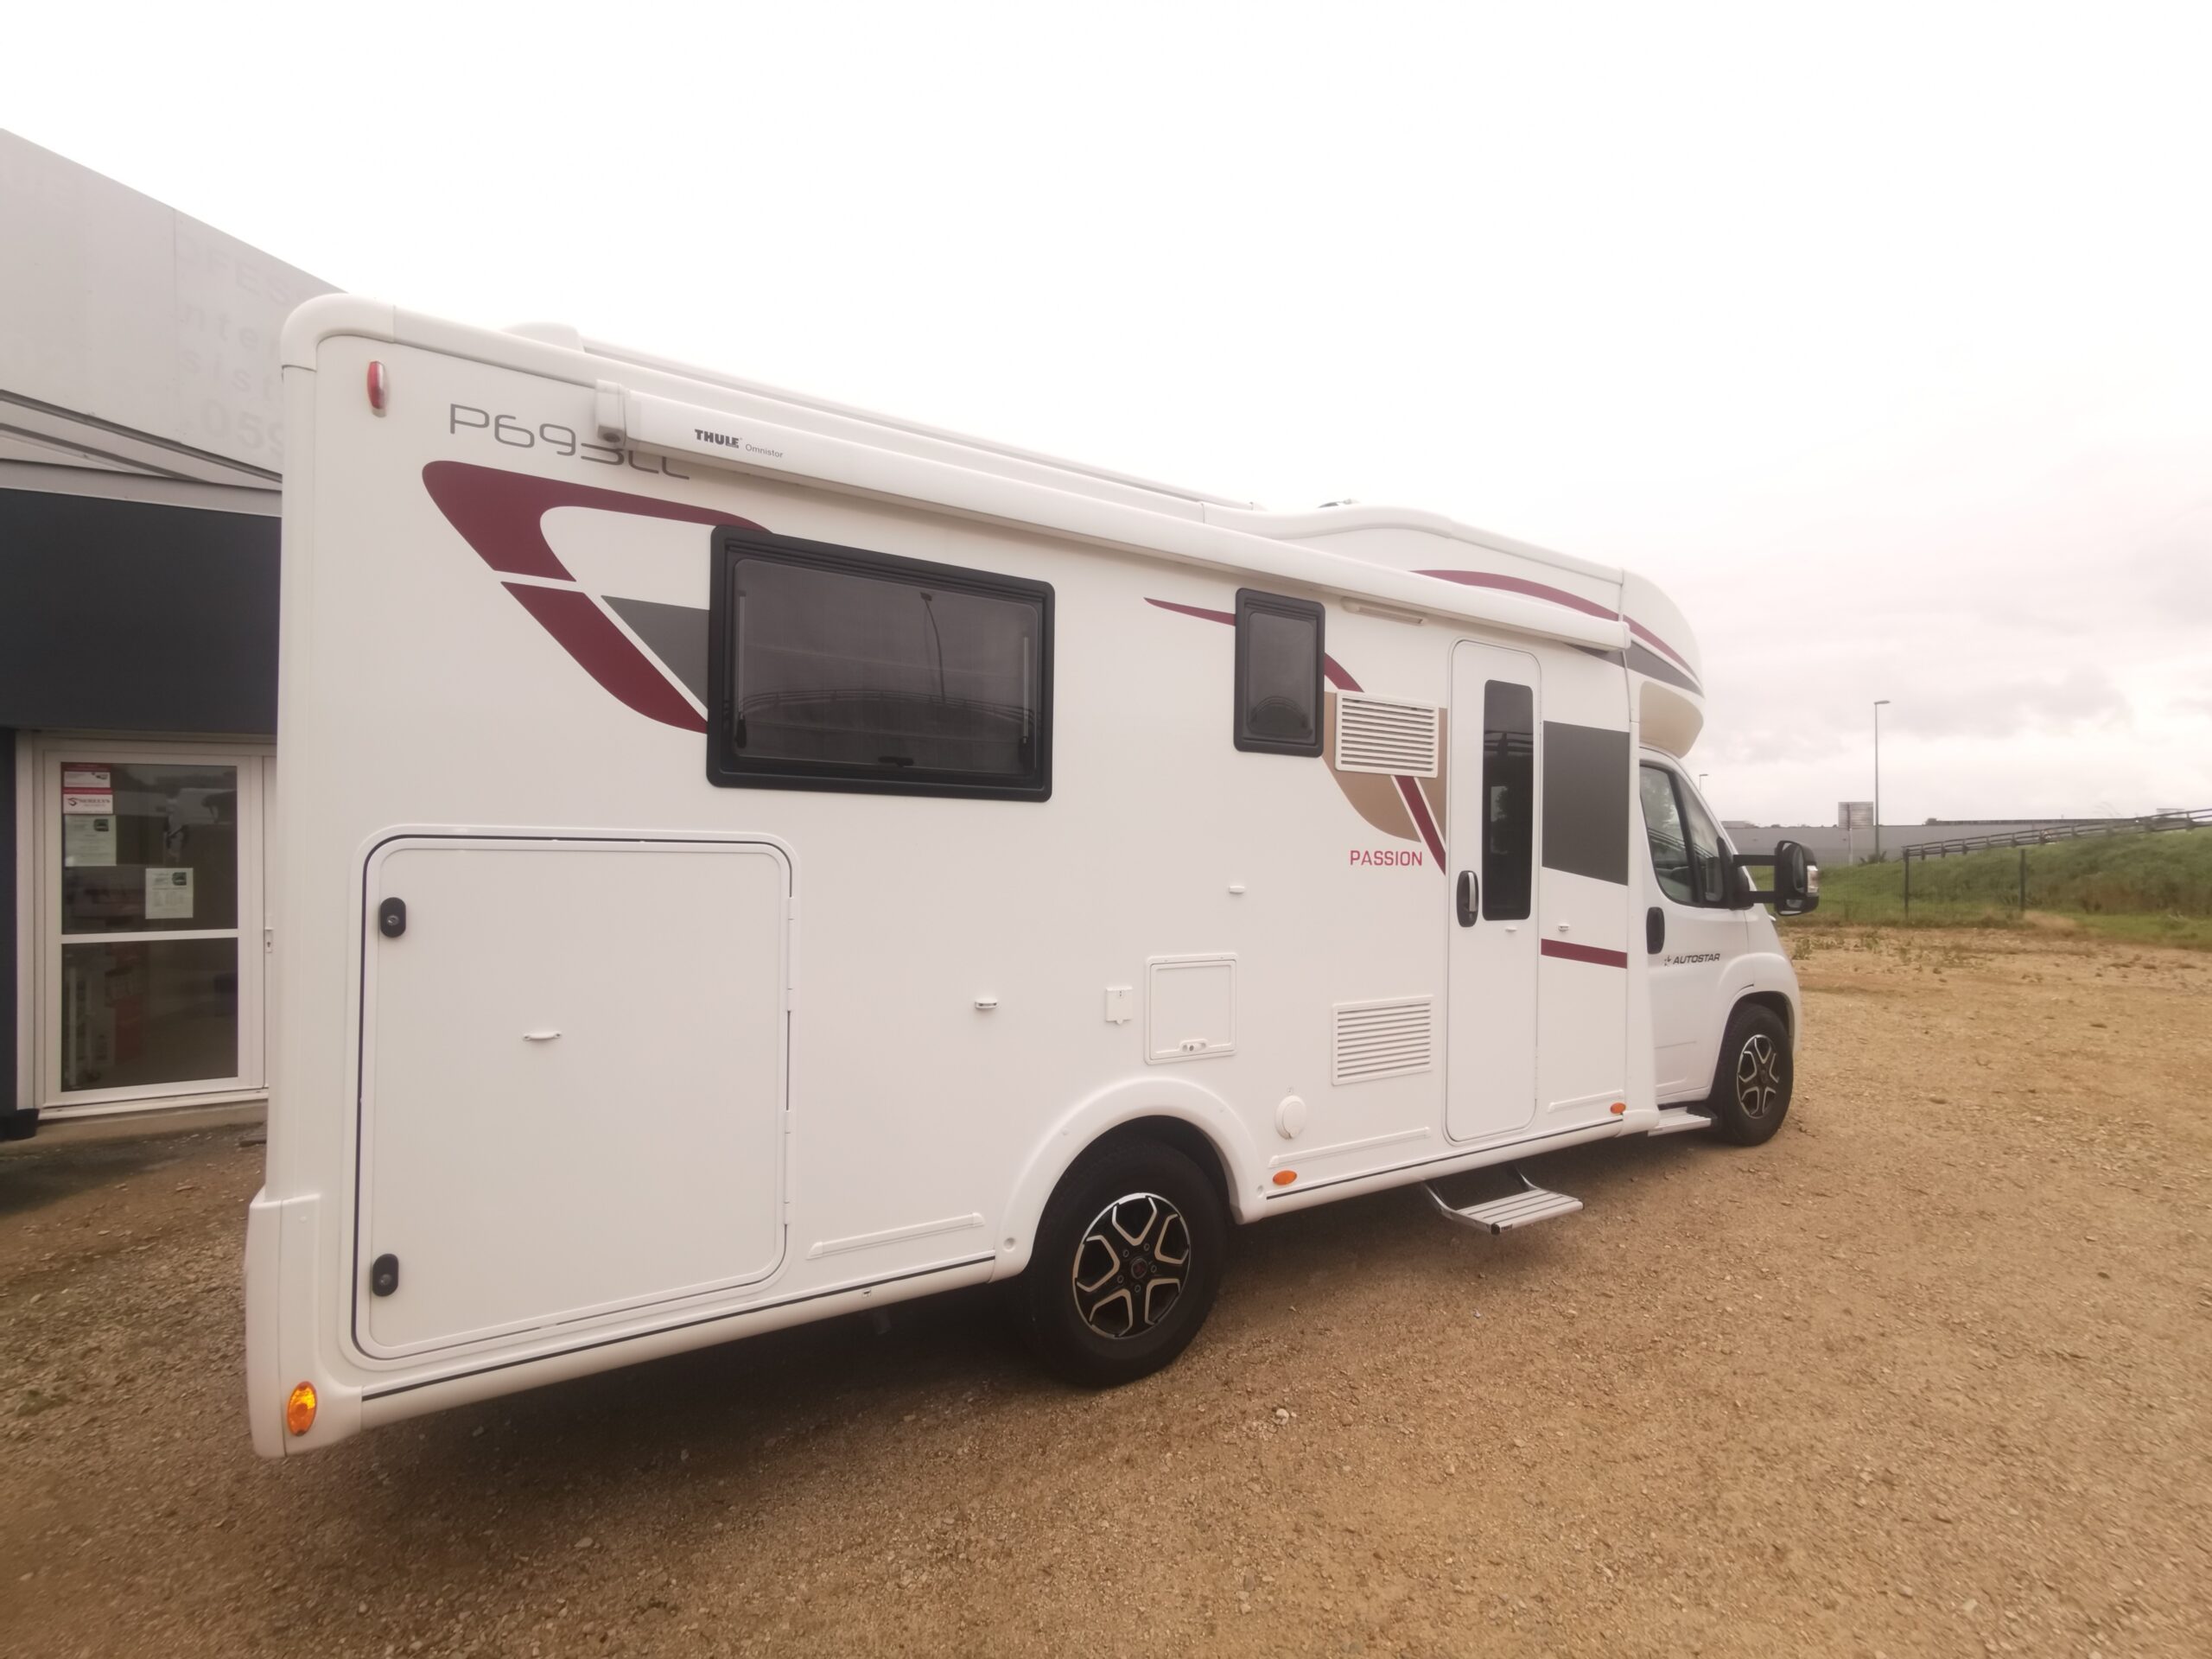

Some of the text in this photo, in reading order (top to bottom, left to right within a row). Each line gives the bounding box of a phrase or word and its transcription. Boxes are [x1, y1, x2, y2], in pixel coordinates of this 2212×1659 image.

[694, 429, 784, 458] THULE Omnistor
[1350, 850, 1422, 866] PASSION
[1673, 953, 1720, 964] AUTOSTAR
